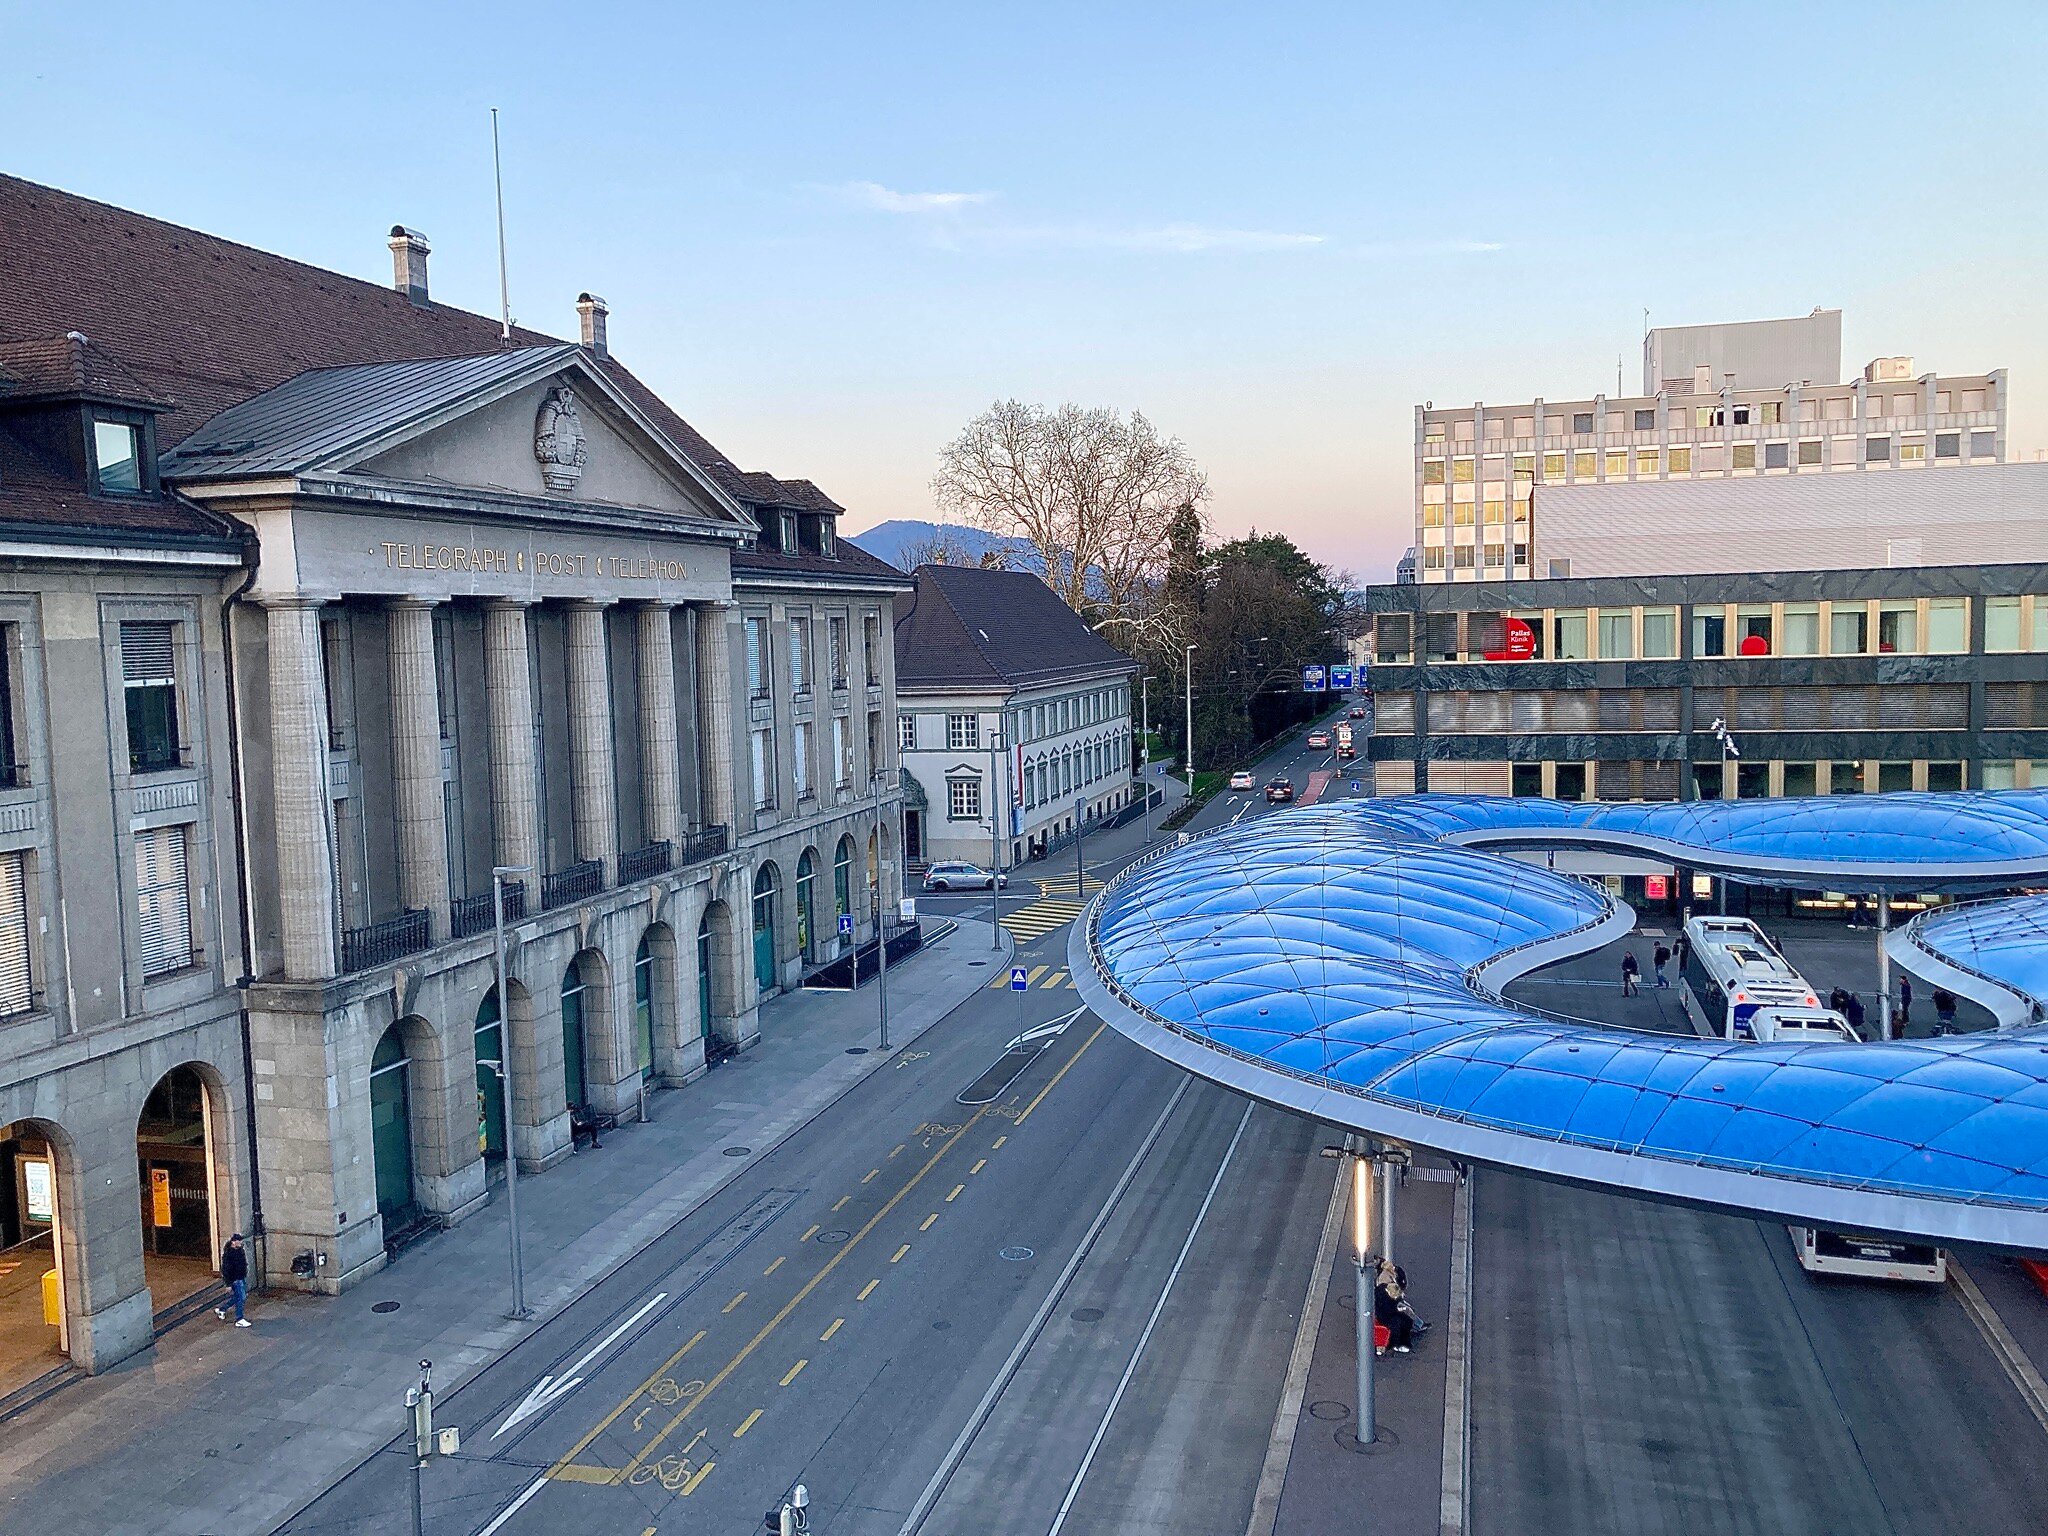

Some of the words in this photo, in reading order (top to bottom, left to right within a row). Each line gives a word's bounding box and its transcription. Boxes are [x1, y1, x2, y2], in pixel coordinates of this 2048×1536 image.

[381, 542, 508, 573] TELEGRAPH
[536, 552, 586, 576] POST
[608, 557, 688, 580] TELEPHON
